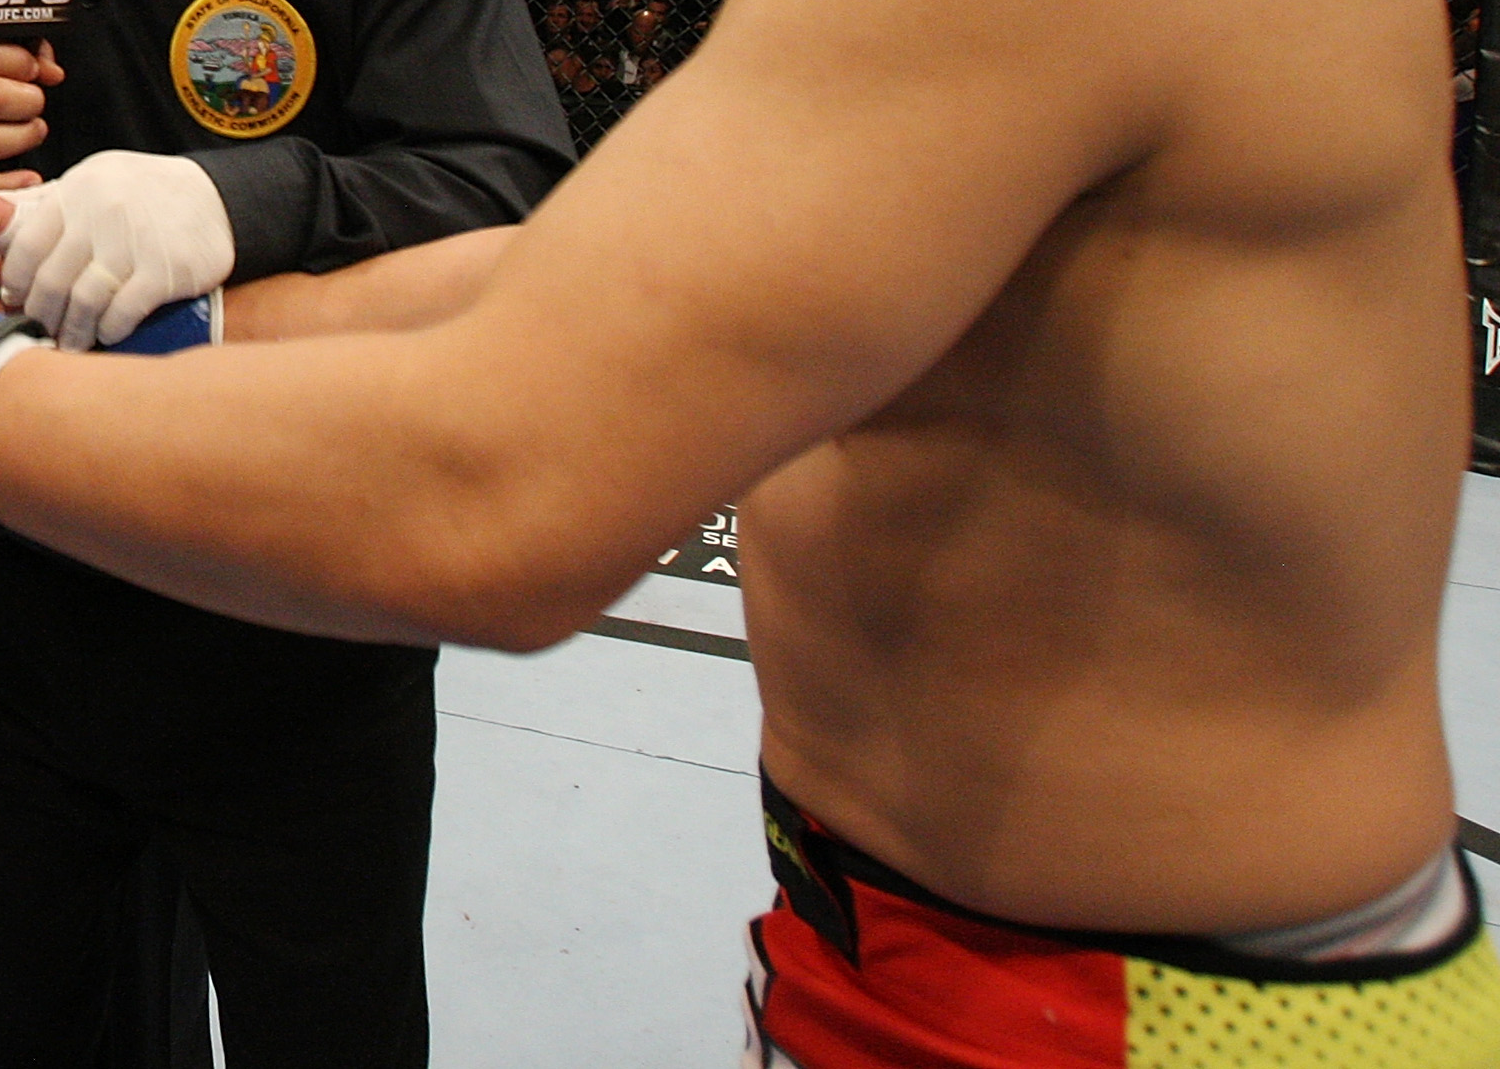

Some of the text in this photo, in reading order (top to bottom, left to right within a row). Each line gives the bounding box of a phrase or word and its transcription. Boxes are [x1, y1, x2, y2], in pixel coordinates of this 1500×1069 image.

[185, 2, 213, 30] STATE
[182, 85, 301, 131] ATHLETIC COMMISSION
